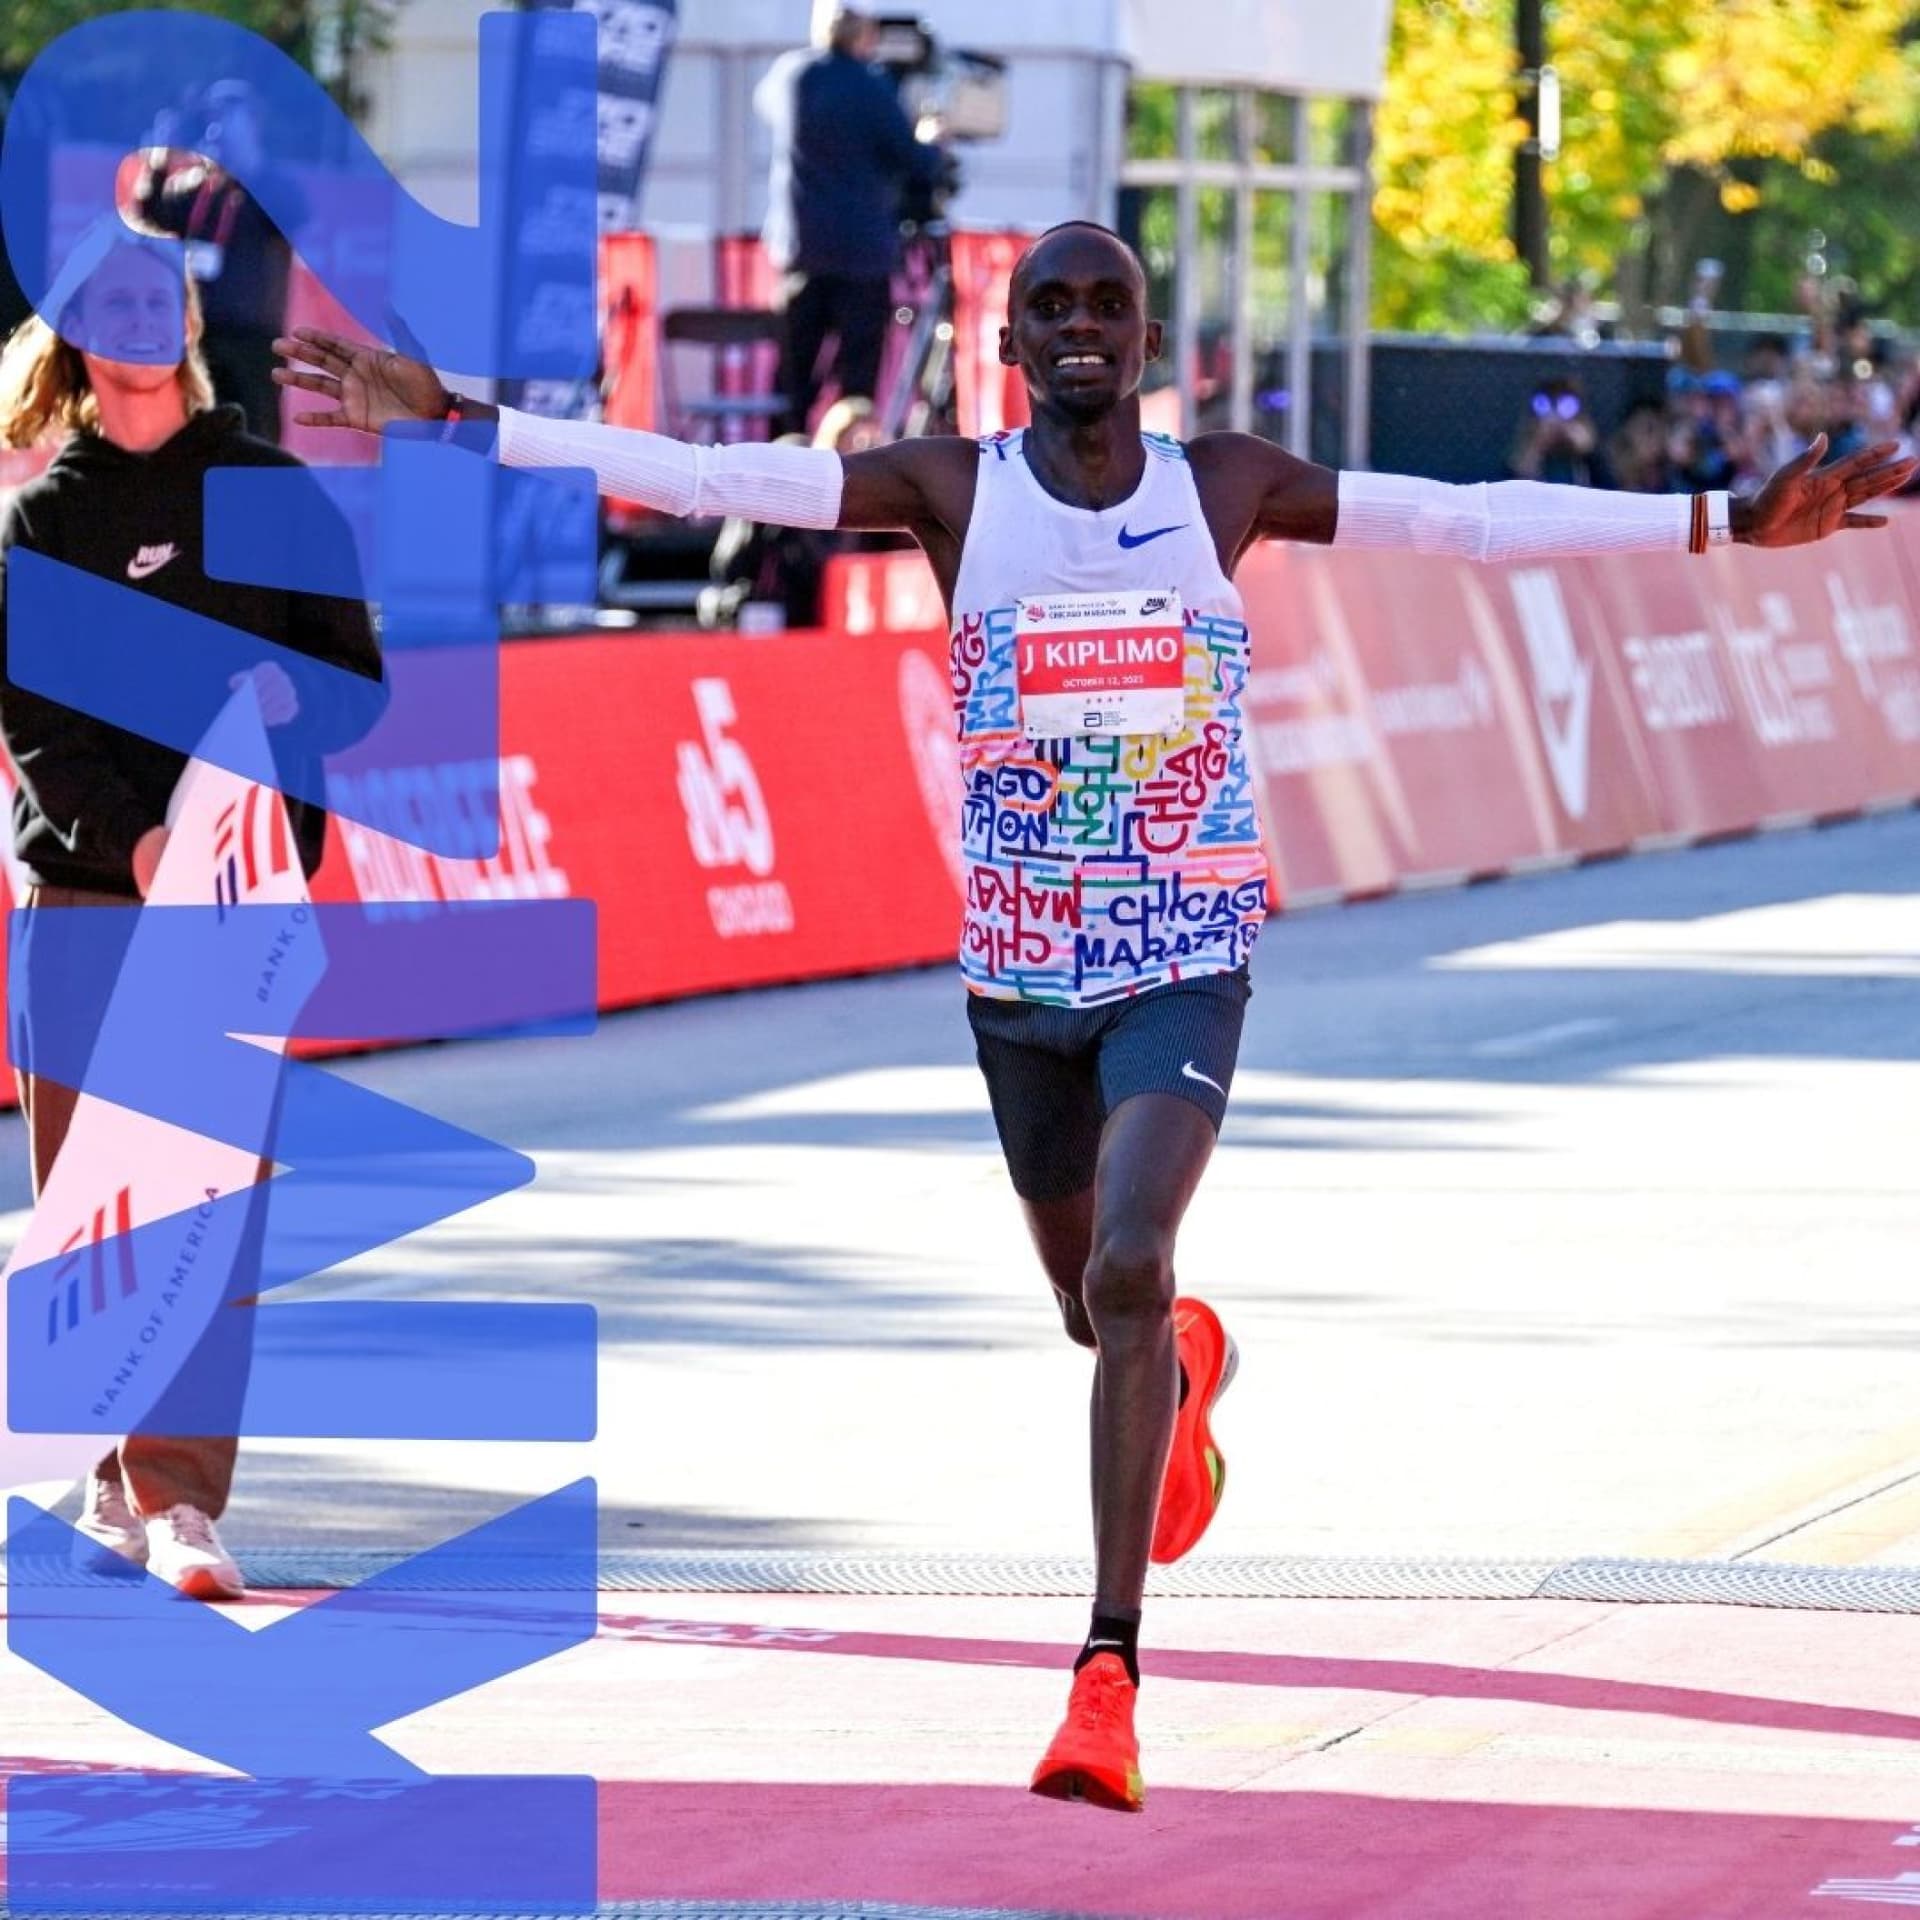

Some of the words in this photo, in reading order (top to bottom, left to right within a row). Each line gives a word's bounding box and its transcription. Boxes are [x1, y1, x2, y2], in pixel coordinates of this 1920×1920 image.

[1084, 608, 1126, 617] MARATHON
[1021, 644, 1034, 676] J
[1045, 637, 1178, 669] KIPLIMO
[1062, 677, 1104, 688] OCTOBER
[91, 1350, 143, 1418] BANK
[139, 1310, 165, 1346] OF
[162, 1186, 220, 1308] AMERICA
